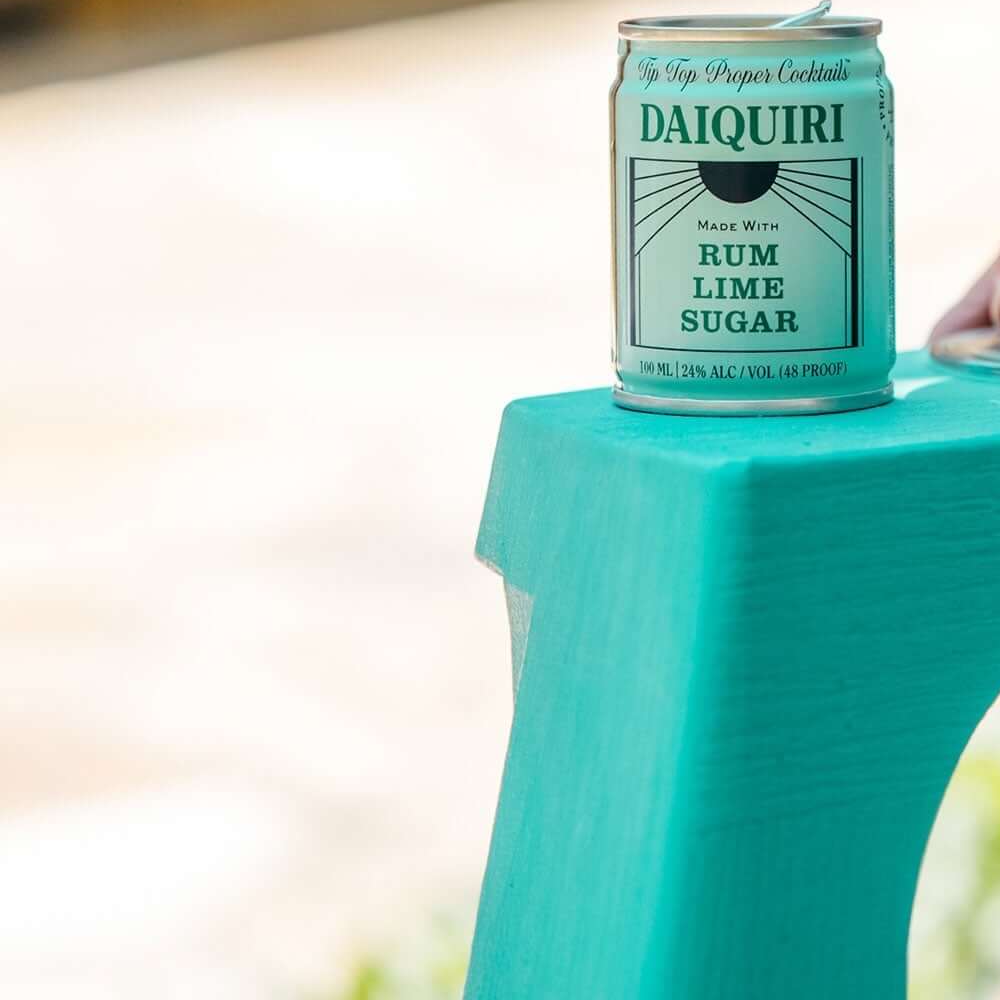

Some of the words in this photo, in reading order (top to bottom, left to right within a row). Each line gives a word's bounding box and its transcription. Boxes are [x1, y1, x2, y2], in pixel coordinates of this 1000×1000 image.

[637, 57, 660, 90] Tip
[665, 58, 697, 92] Top
[705, 57, 772, 93] Proper
[640, 103, 844, 152] DAIQUIRI
[698, 244, 779, 266] RUM
[693, 277, 784, 299] LIME
[681, 309, 799, 333] SUGAR
[639, 360, 654, 374] 100
[657, 363, 673, 377] ML
[682, 363, 706, 378] 24%
[710, 365, 737, 379] ALC
[748, 365, 775, 379] VOL
[779, 363, 799, 379] (48
[802, 361, 848, 378] PROOF)
